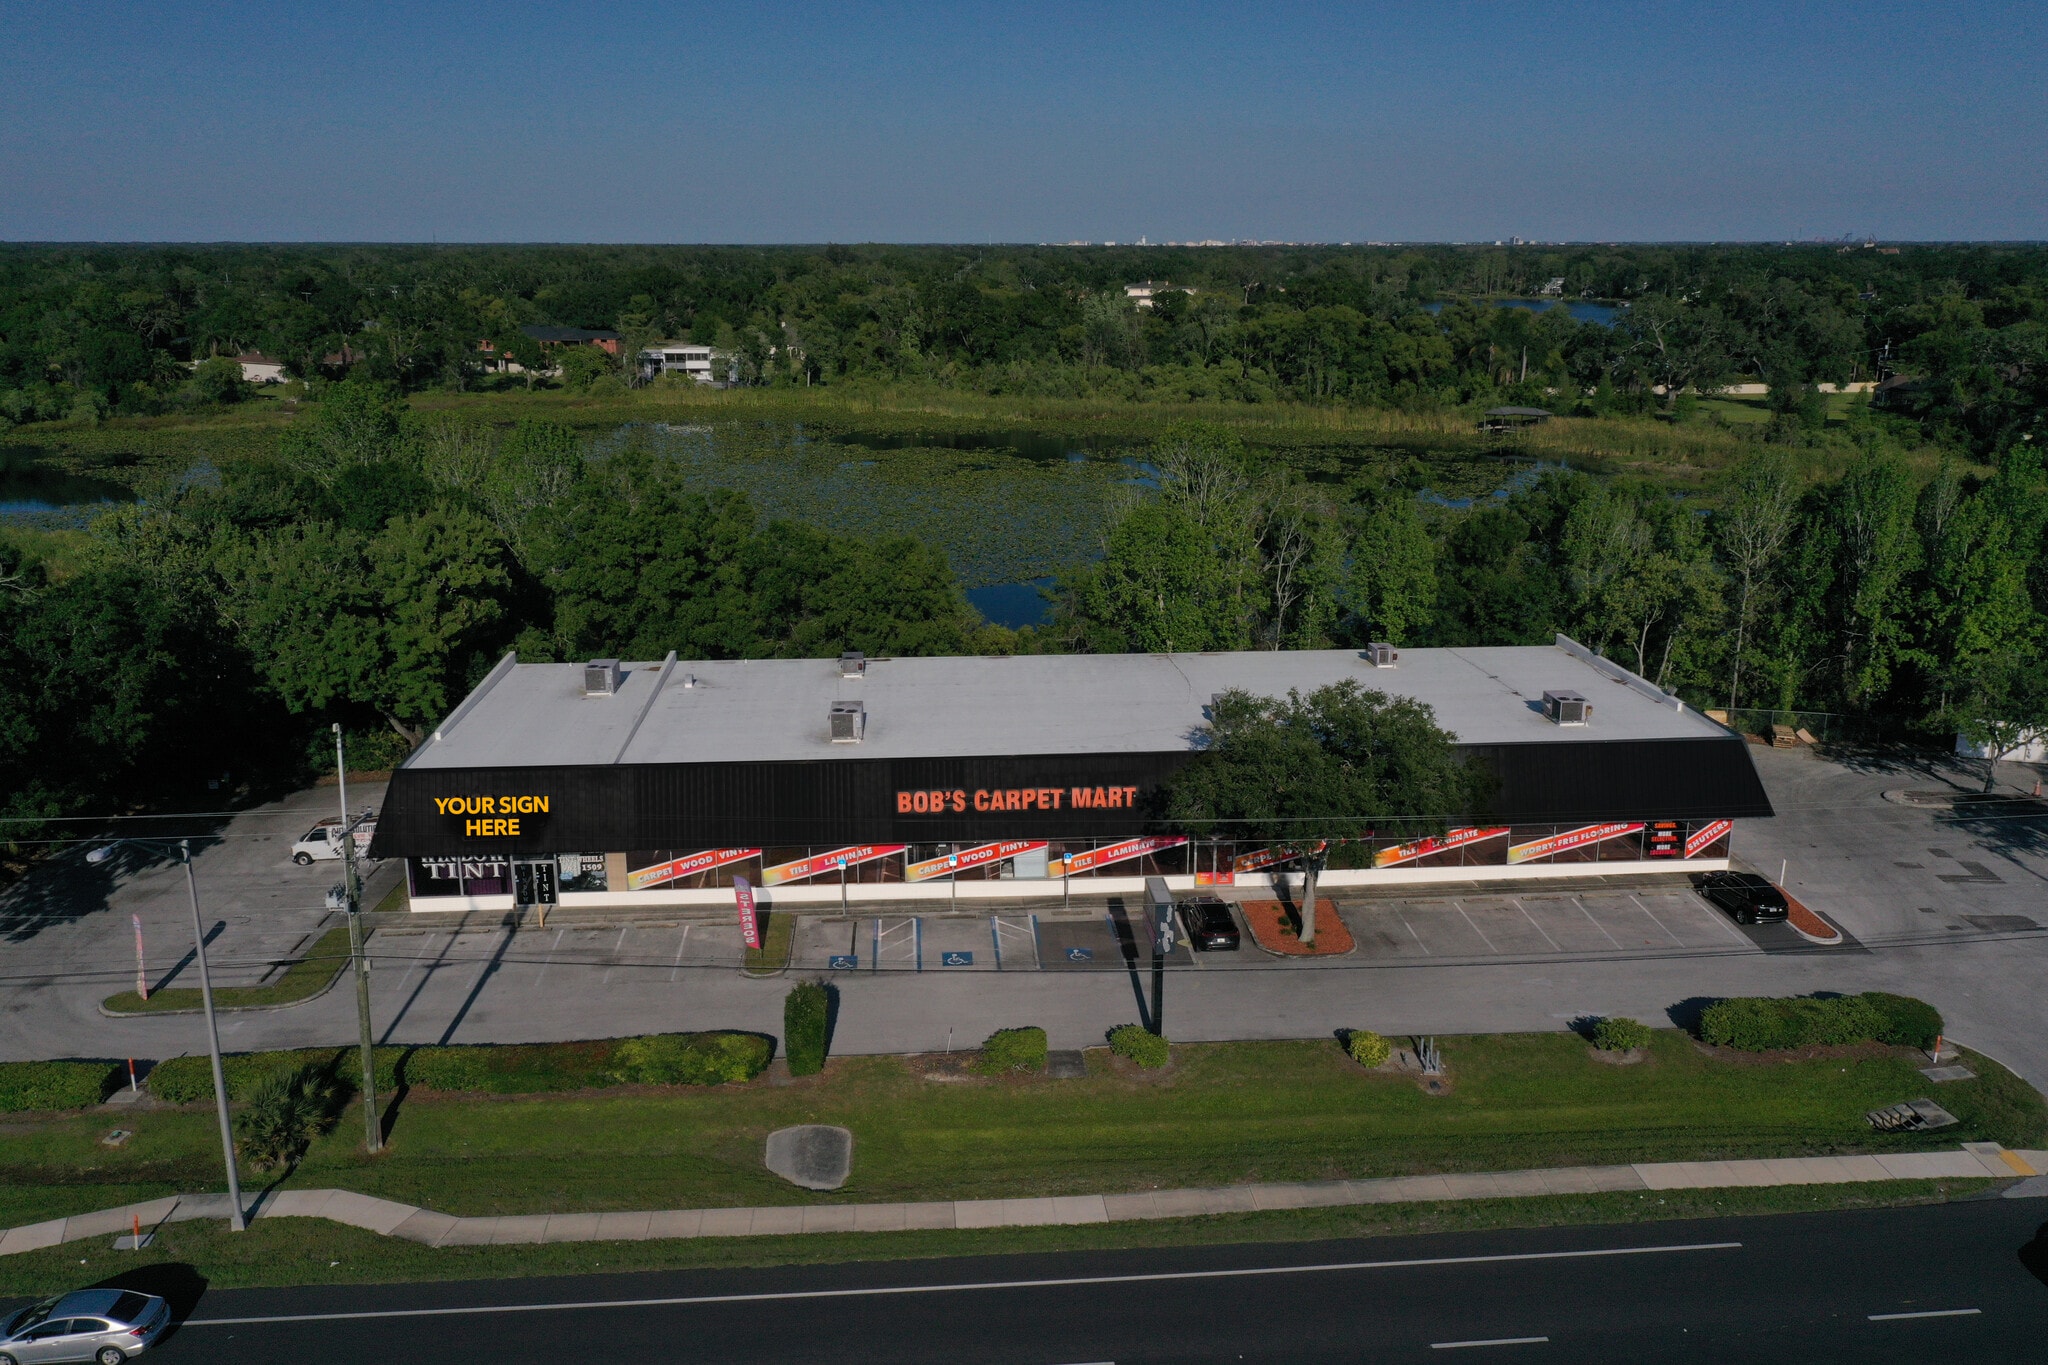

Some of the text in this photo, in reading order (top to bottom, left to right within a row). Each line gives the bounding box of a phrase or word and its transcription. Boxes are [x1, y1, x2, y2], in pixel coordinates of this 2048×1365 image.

[434, 795, 549, 815] YOUR SIGN
[897, 786, 1137, 813] BOB'S CARPET MART
[465, 818, 521, 837] HERE
[1580, 823, 1629, 841] FLOORING
[1686, 820, 1729, 851] SHUTTERS
[788, 846, 873, 876] TILE LAMINATE
[918, 841, 1030, 875] CARPE WOOD VINYL
[1073, 839, 1156, 868] TILE LAMINATE
[1241, 853, 1272, 867] CARP
[1398, 846, 1417, 857] TILE
[422, 861, 509, 880] TINT
[637, 866, 673, 883] CARPET
[680, 855, 713, 870] WOOD
[540, 864, 550, 902] TINT
